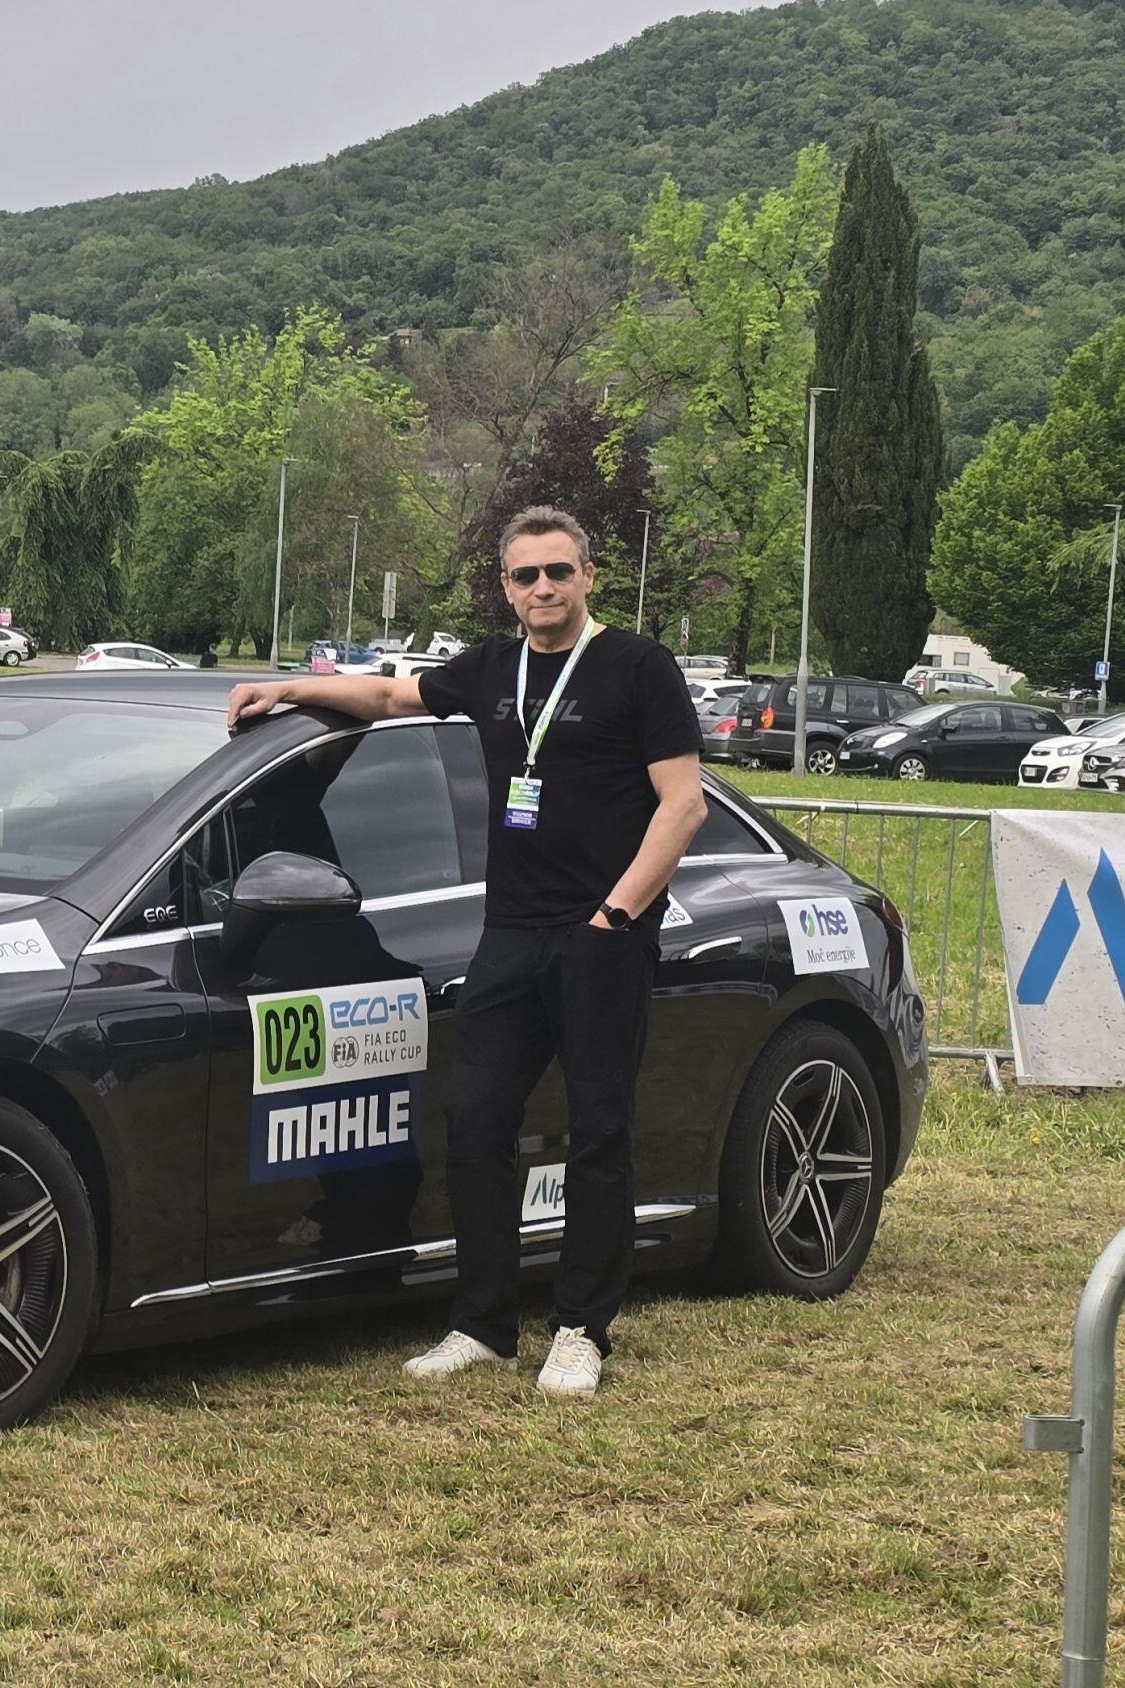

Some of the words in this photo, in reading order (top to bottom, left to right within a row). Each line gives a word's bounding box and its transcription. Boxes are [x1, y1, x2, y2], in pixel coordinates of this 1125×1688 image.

[811, 904, 849, 936] hse
[264, 1003, 322, 1075] 023
[365, 1033, 382, 1047] FIA
[385, 1029, 406, 1043] ECO
[364, 1050, 396, 1066] RALLY
[400, 1045, 422, 1060] CUP
[268, 1090, 410, 1164] MAHLE
